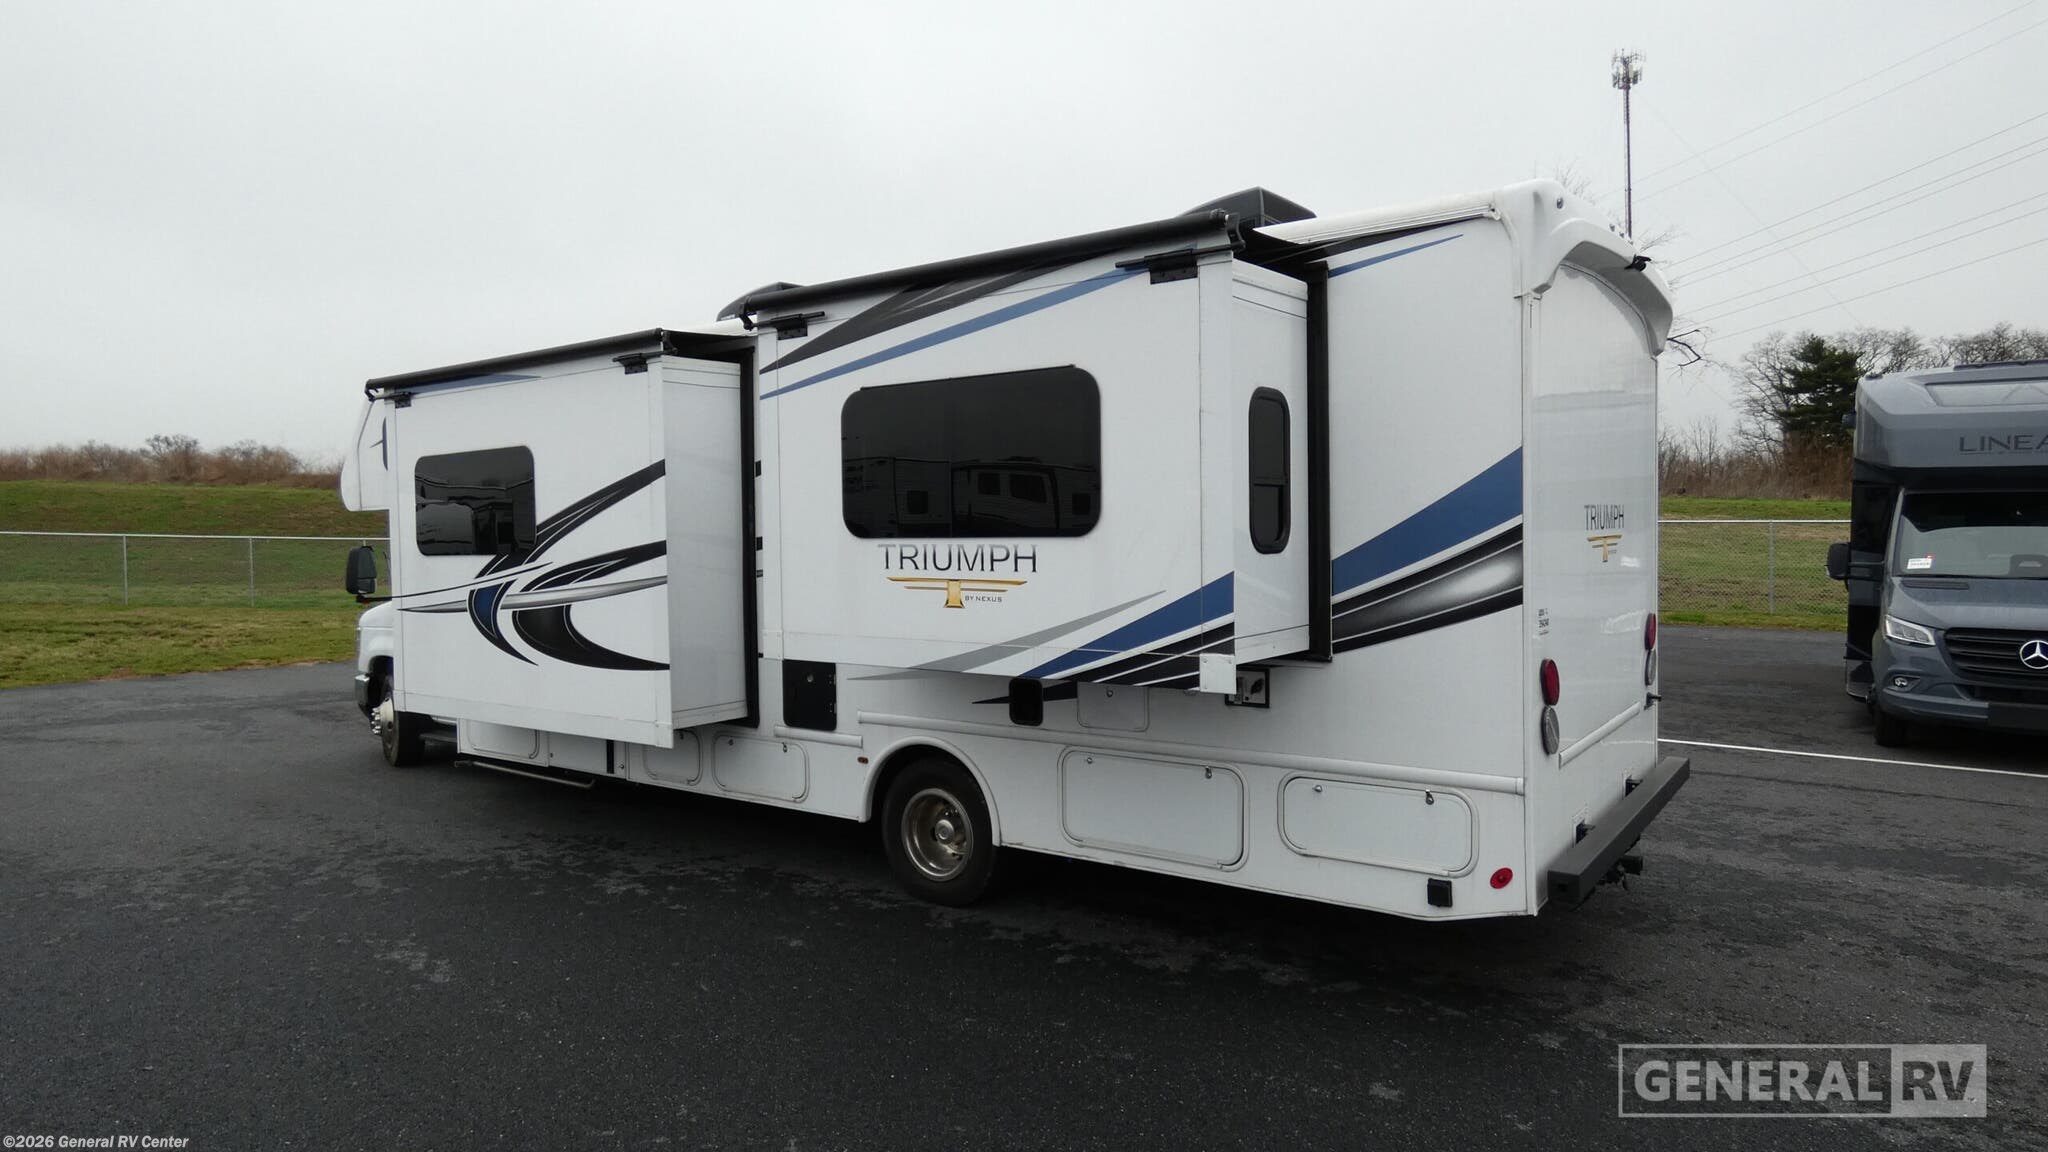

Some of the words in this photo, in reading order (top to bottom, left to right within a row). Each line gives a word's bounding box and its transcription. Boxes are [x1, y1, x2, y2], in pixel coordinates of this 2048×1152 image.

[1584, 504, 1625, 530] TRIUMPH
[878, 543, 1037, 573] TRIUMPH
[975, 595, 1003, 603] NEXUS
